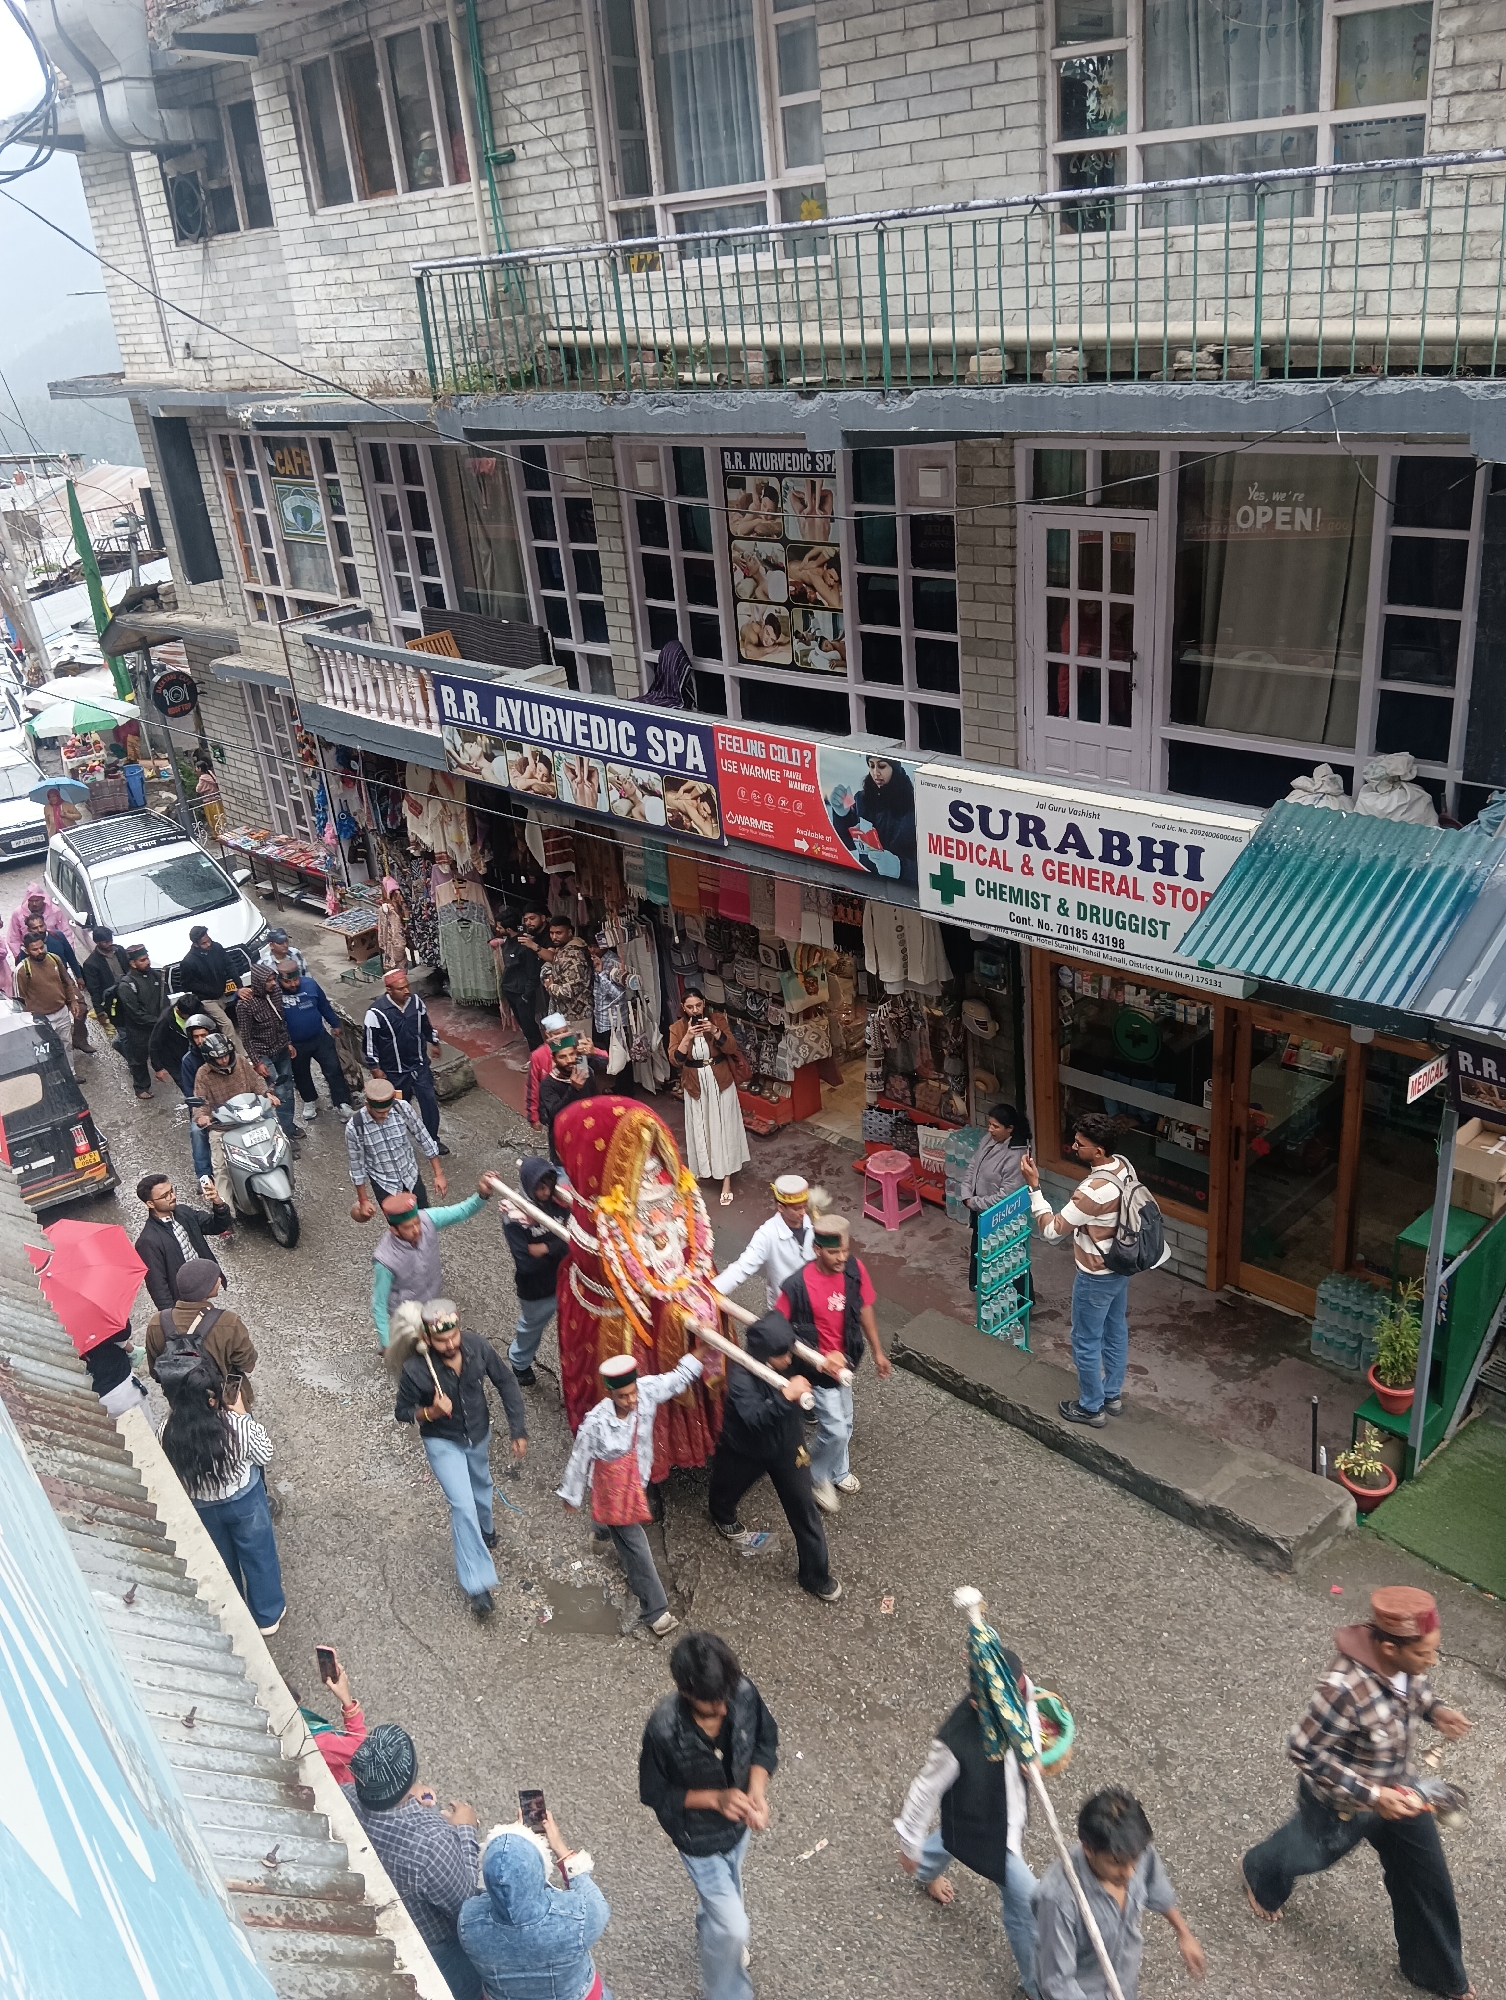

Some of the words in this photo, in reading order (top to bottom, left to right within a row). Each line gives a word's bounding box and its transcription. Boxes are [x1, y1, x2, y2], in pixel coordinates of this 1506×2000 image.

[274, 447, 313, 476] CAFE
[724, 452, 746, 470] R.R.
[749, 452, 812, 472] AYURVEDIC
[1248, 482, 1270, 502] Yes,
[1272, 490, 1305, 502] we're
[1236, 505, 1322, 532] OPEN!
[168, 703, 192, 716] ROOFTOP
[440, 684, 488, 726] R.R.
[496, 696, 638, 758] AYURVEDIC
[646, 726, 706, 773] SPA
[718, 732, 766, 759] FEELING
[769, 744, 801, 766] COLD
[720, 758, 738, 774] USE
[740, 762, 782, 783] WARMEE
[782, 769, 802, 780] TRAVEL
[734, 814, 774, 832] WARMEE
[1048, 804, 1066, 814] Guru
[1068, 807, 1100, 820] Vashisht
[796, 827, 824, 841] Available
[948, 800, 1206, 882] SURABHI
[928, 832, 1014, 872] MEDICAL
[1020, 854, 1034, 876] &
[1042, 858, 1144, 902] GENERAL
[975, 878, 1051, 912] CHEMIST
[1056, 898, 1070, 918] &
[1076, 900, 1170, 940] DRUGGIST
[1009, 912, 1034, 928] Cont.
[1038, 918, 1053, 932] No.
[1056, 923, 1088, 940] 70185
[1092, 932, 1125, 950] 43198
[1036, 936, 1054, 946] Hotel
[1054, 940, 1081, 954] Surabhi,
[1102, 952, 1128, 966] Manali,
[1128, 959, 1154, 972] District
[1154, 966, 1174, 976] Kullu
[1174, 970, 1194, 982] (H.P.)
[1195, 975, 1222, 988] 175131
[34, 1042, 50, 1056] 247
[1410, 1060, 1444, 1099] MEDICAL
[1458, 1050, 1506, 1083] R.R.
[991, 1196, 1022, 1228] Bisleri
